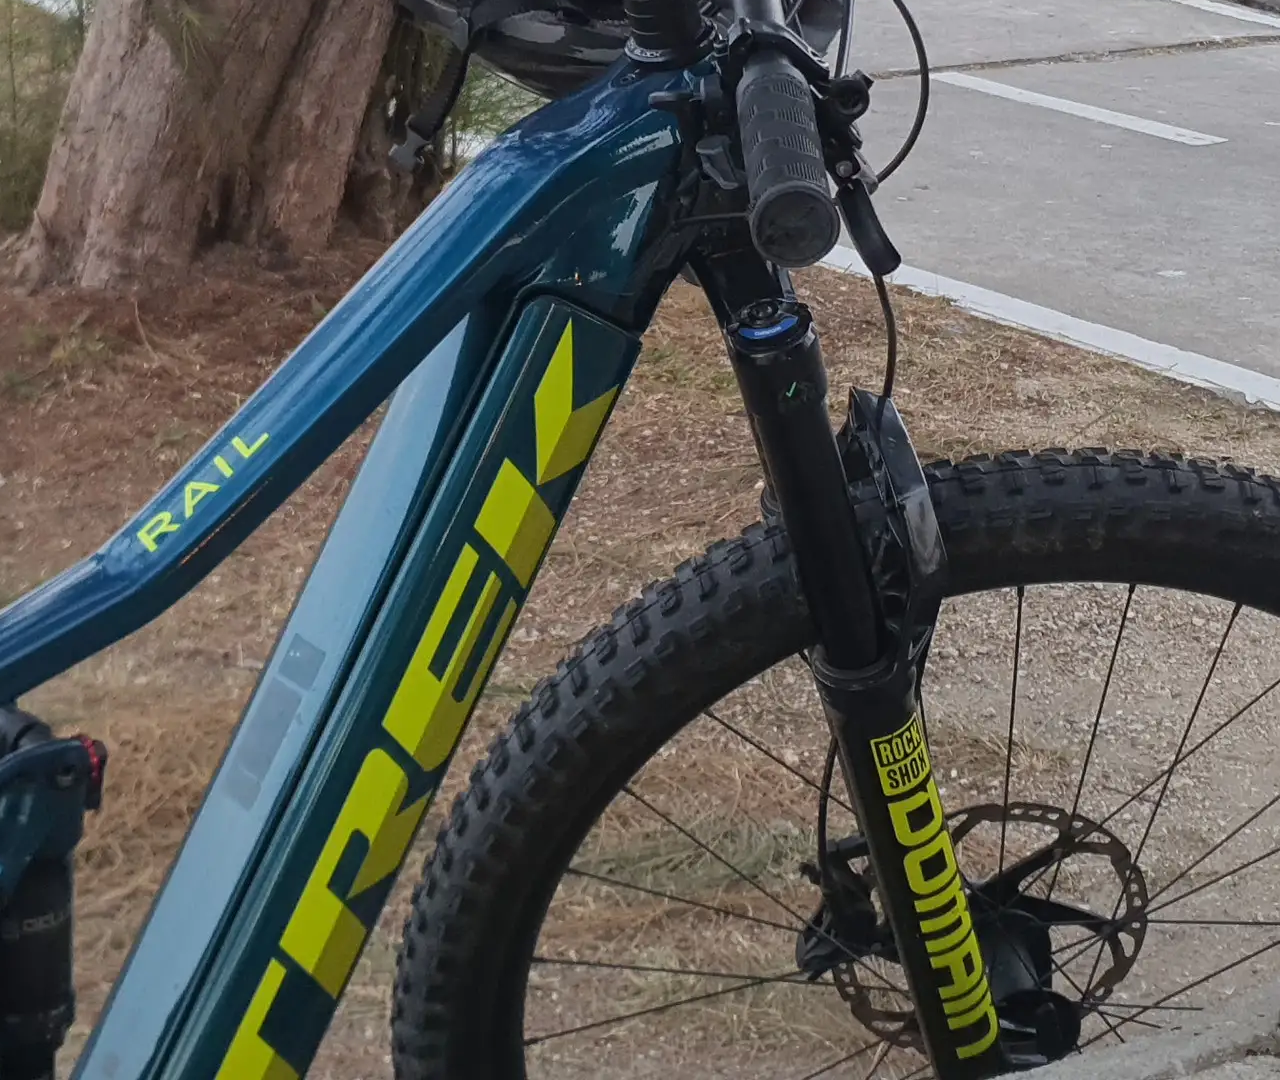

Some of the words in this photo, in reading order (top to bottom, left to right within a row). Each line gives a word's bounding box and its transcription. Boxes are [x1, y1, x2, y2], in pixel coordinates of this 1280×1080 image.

[137, 432, 269, 552] RAIL
[878, 721, 921, 765] ROCK
[886, 747, 928, 789] SHOX
[888, 777, 1000, 1059] DOMAIN
